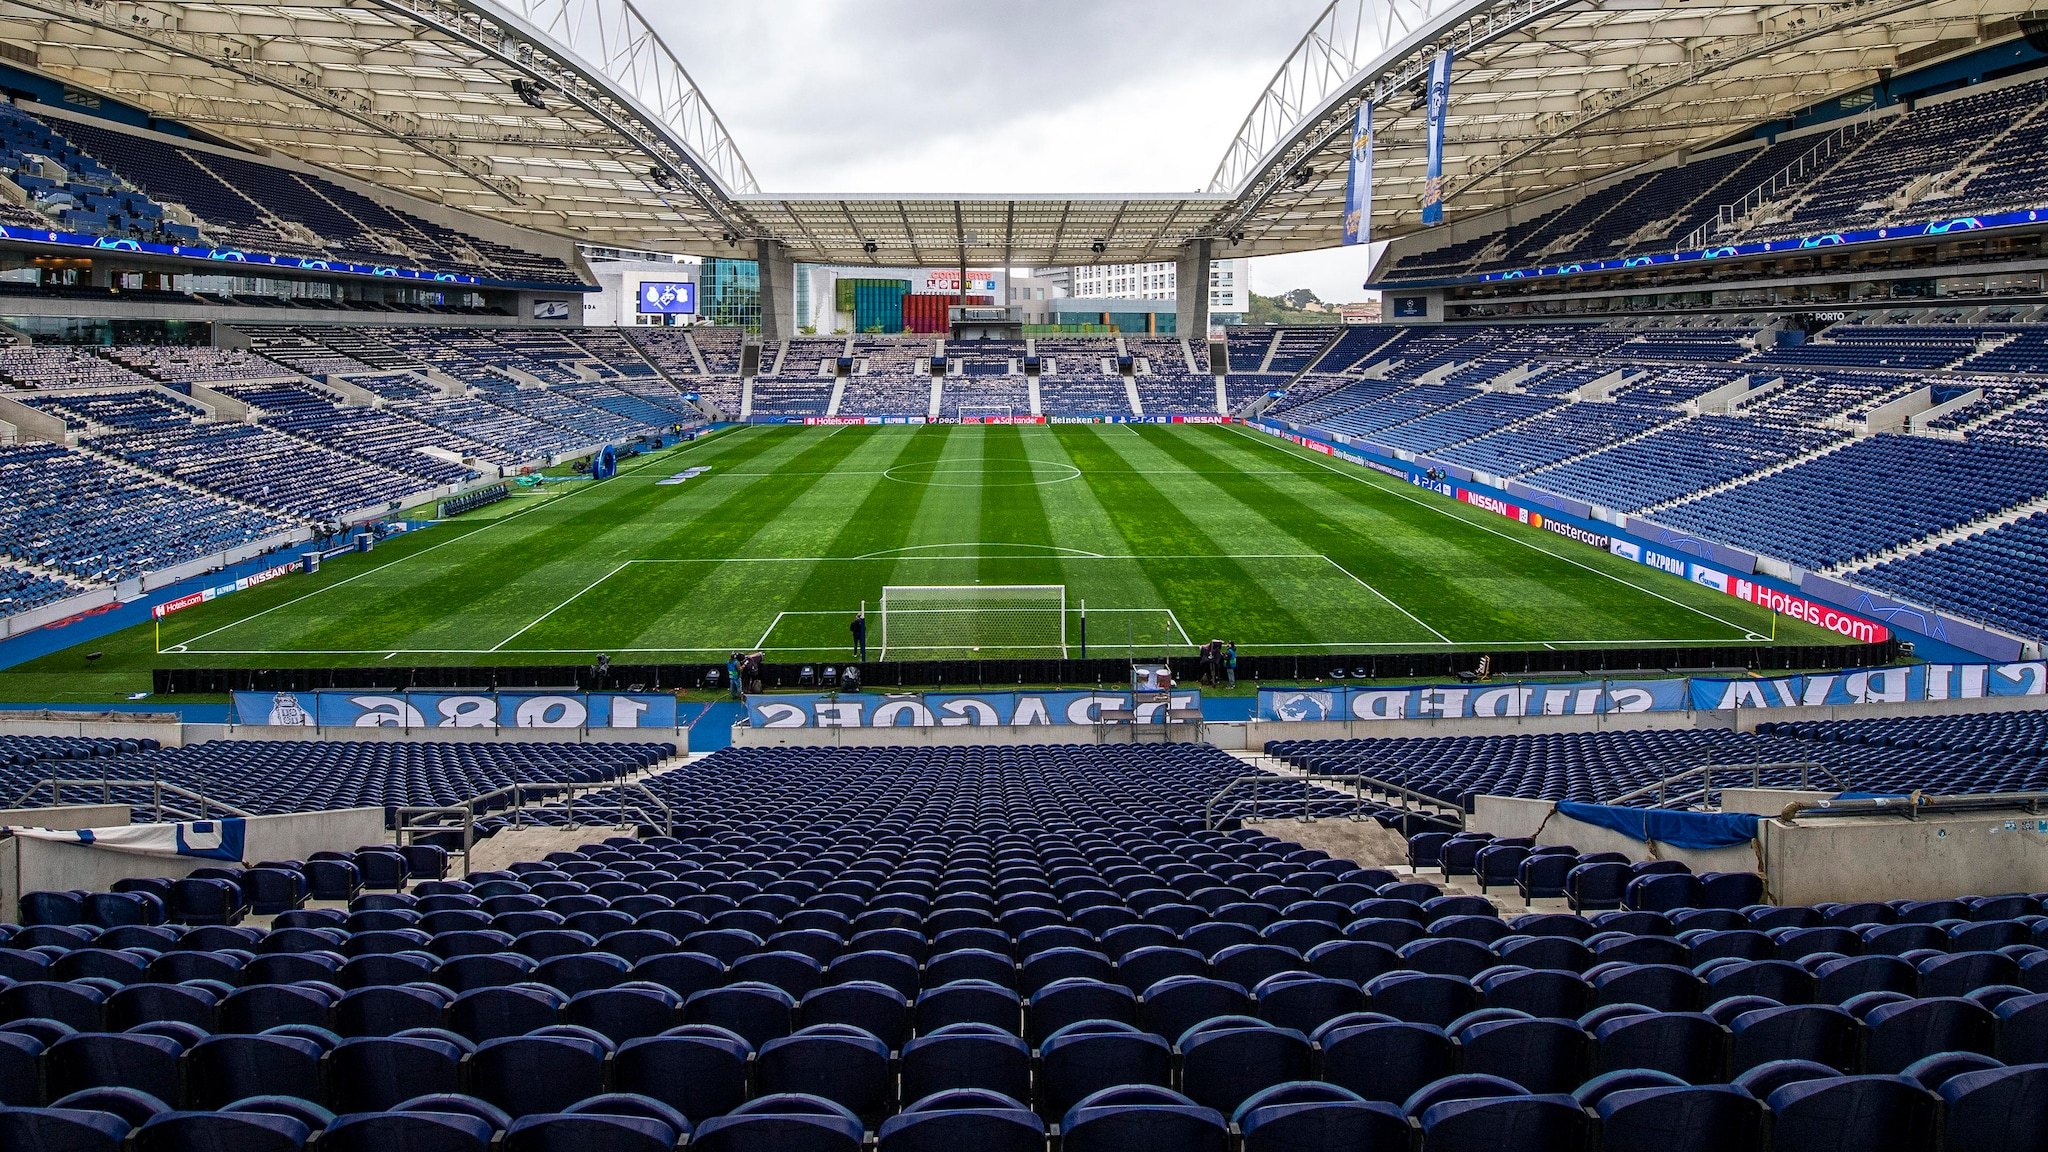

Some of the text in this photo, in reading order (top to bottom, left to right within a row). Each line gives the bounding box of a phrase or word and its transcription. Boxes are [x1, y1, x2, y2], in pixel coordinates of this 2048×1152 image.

[1815, 312, 1845, 321] PORTO
[816, 416, 862, 425] Hotels.com
[938, 417, 960, 426] peps
[1050, 416, 1093, 424] Heineken
[1129, 416, 1156, 424] PS4
[1183, 416, 1222, 424] NISSAN
[1421, 476, 1442, 493] PS4
[1467, 491, 1507, 516] NISSAN
[1544, 517, 1608, 548] mastercard
[1645, 550, 1684, 577] GAZPROM
[248, 564, 286, 587] NISSAN
[166, 595, 202, 613] Hotels.com
[1757, 584, 1873, 644] Hotels.com
